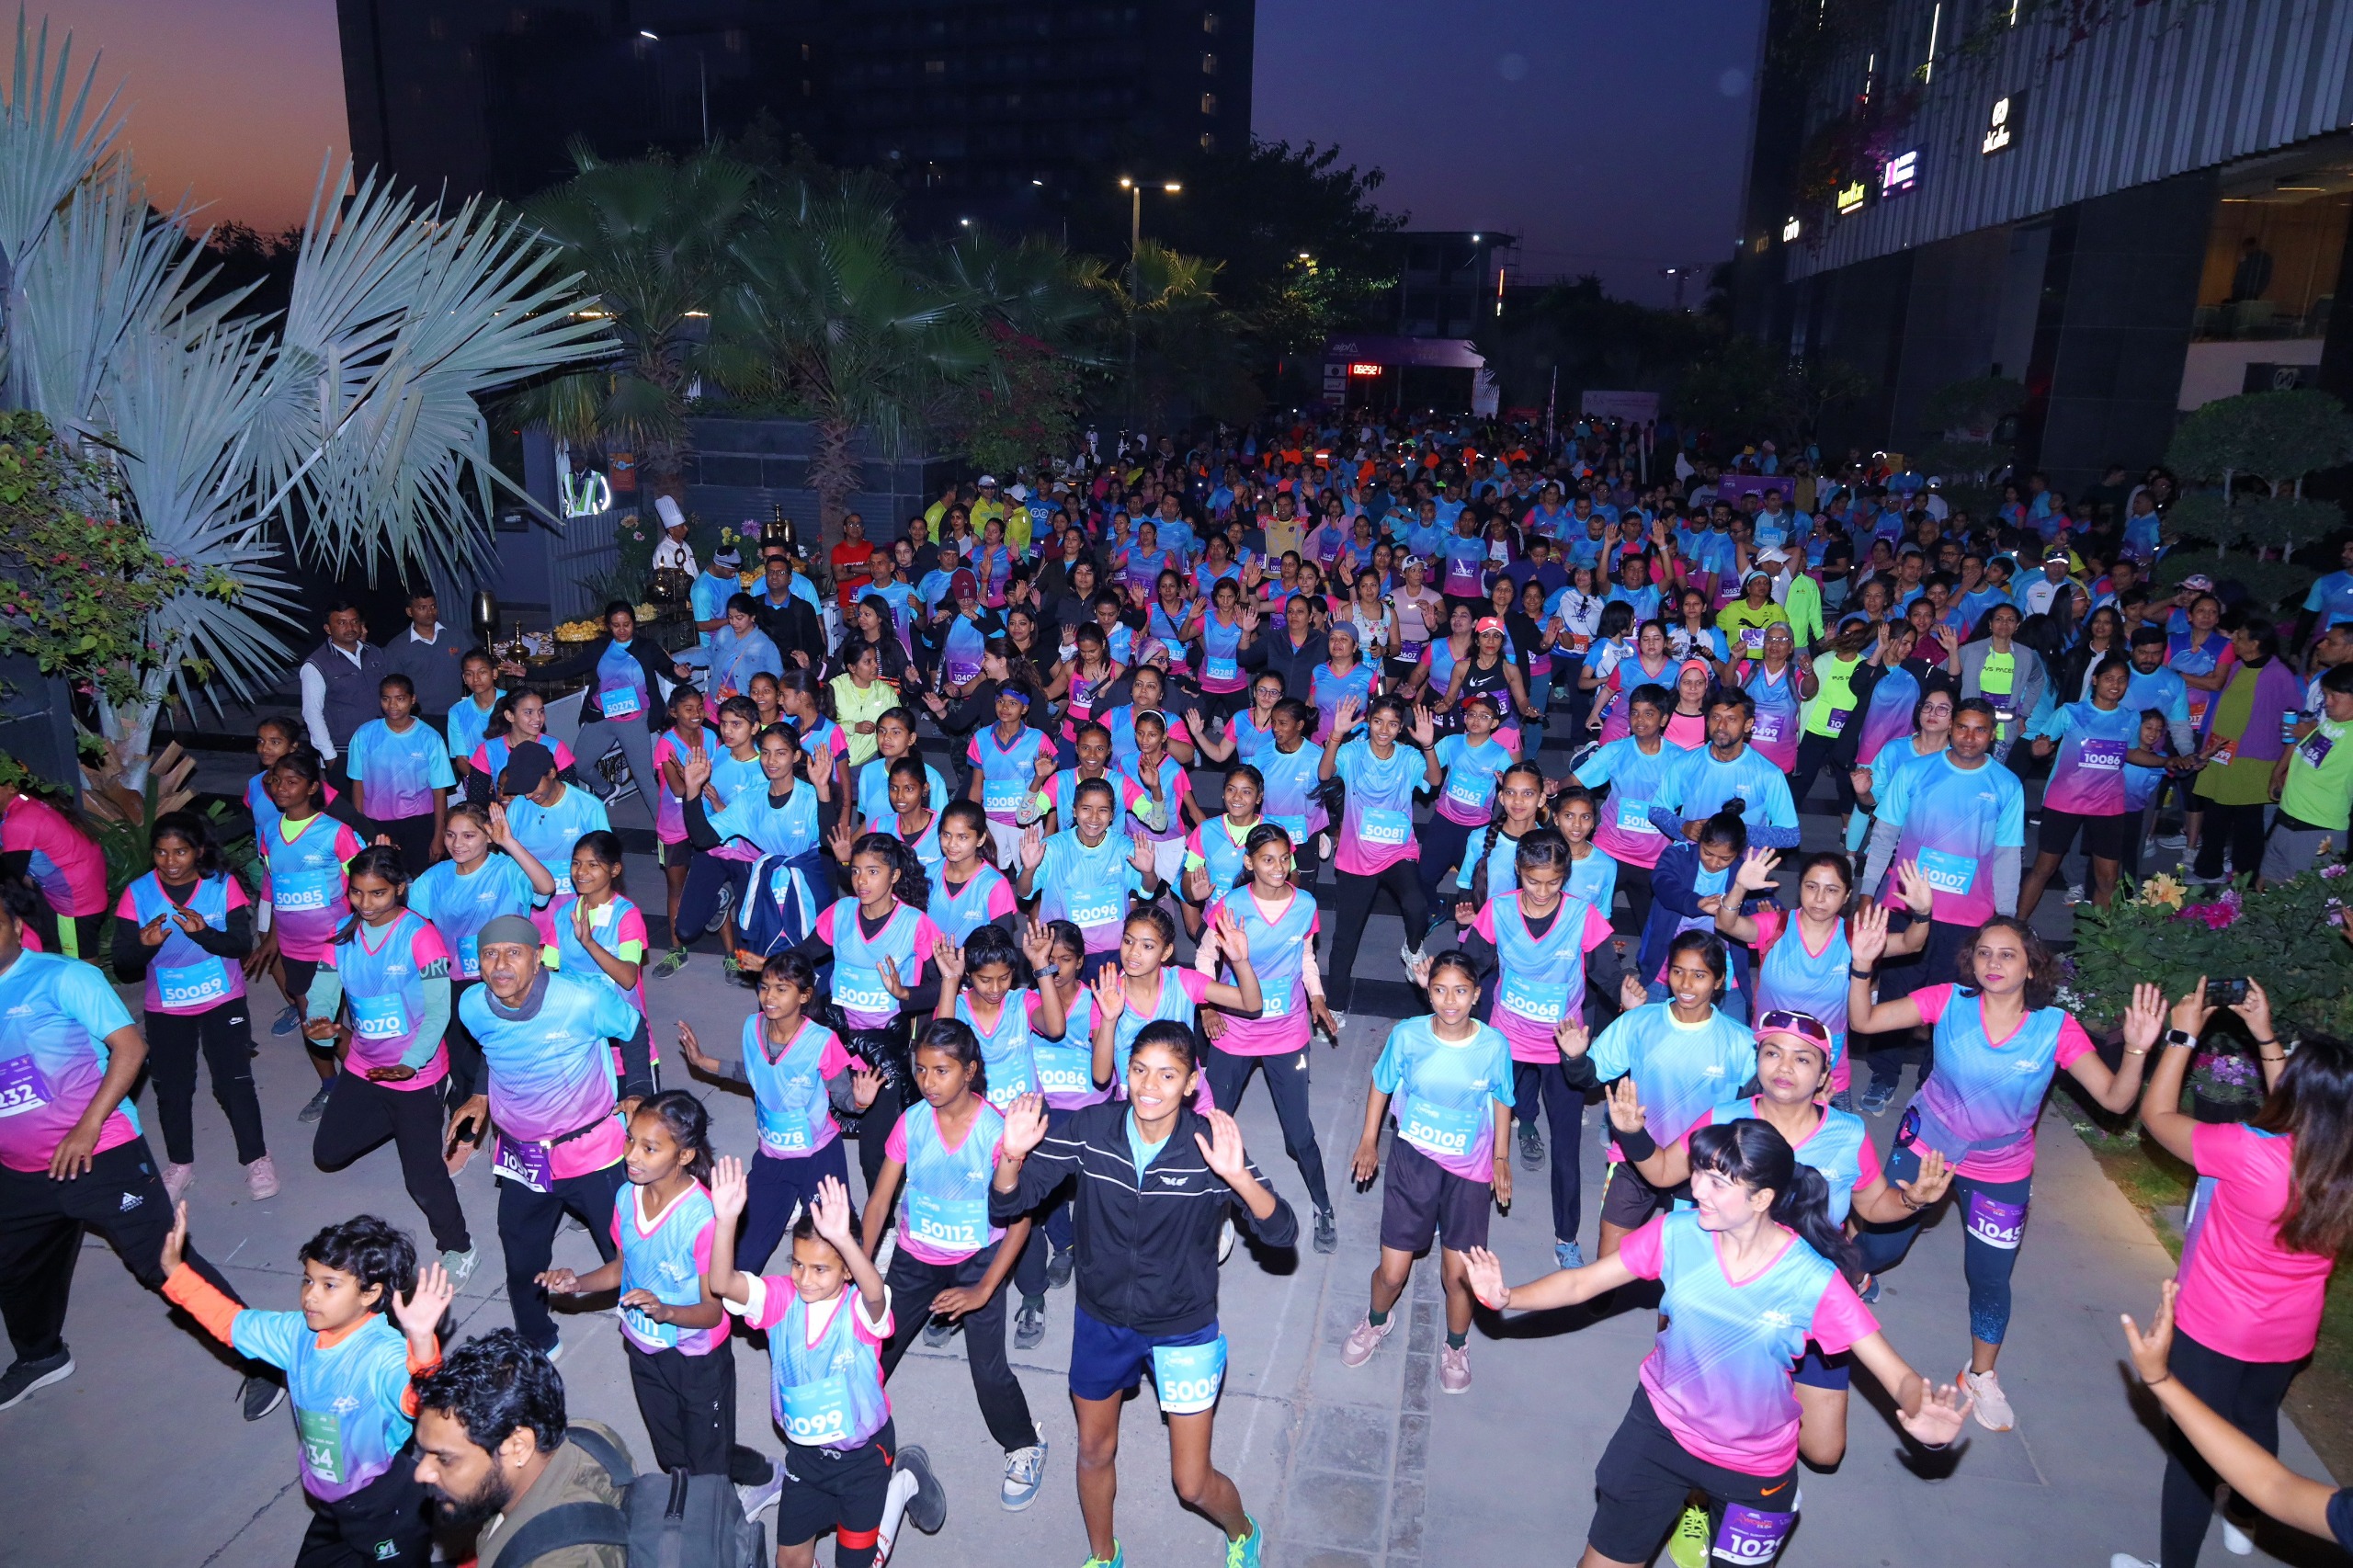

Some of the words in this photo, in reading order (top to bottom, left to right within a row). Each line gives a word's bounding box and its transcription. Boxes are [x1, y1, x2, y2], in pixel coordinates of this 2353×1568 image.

[607, 699, 635, 712] 50279
[2084, 753, 2121, 766] 10086
[1450, 784, 1483, 801] 50162
[1623, 814, 1657, 828] 5016
[1365, 824, 1404, 839] 50081
[276, 889, 324, 904] 50085
[1071, 903, 1119, 922] 50096
[165, 977, 222, 1001] 50089
[838, 985, 890, 1006] 50075
[1505, 991, 1560, 1017] 50068
[352, 1015, 401, 1033] 0070
[1407, 1119, 1467, 1148] 50108
[920, 1217, 975, 1242] 50112
[1977, 1217, 2024, 1242] 1045
